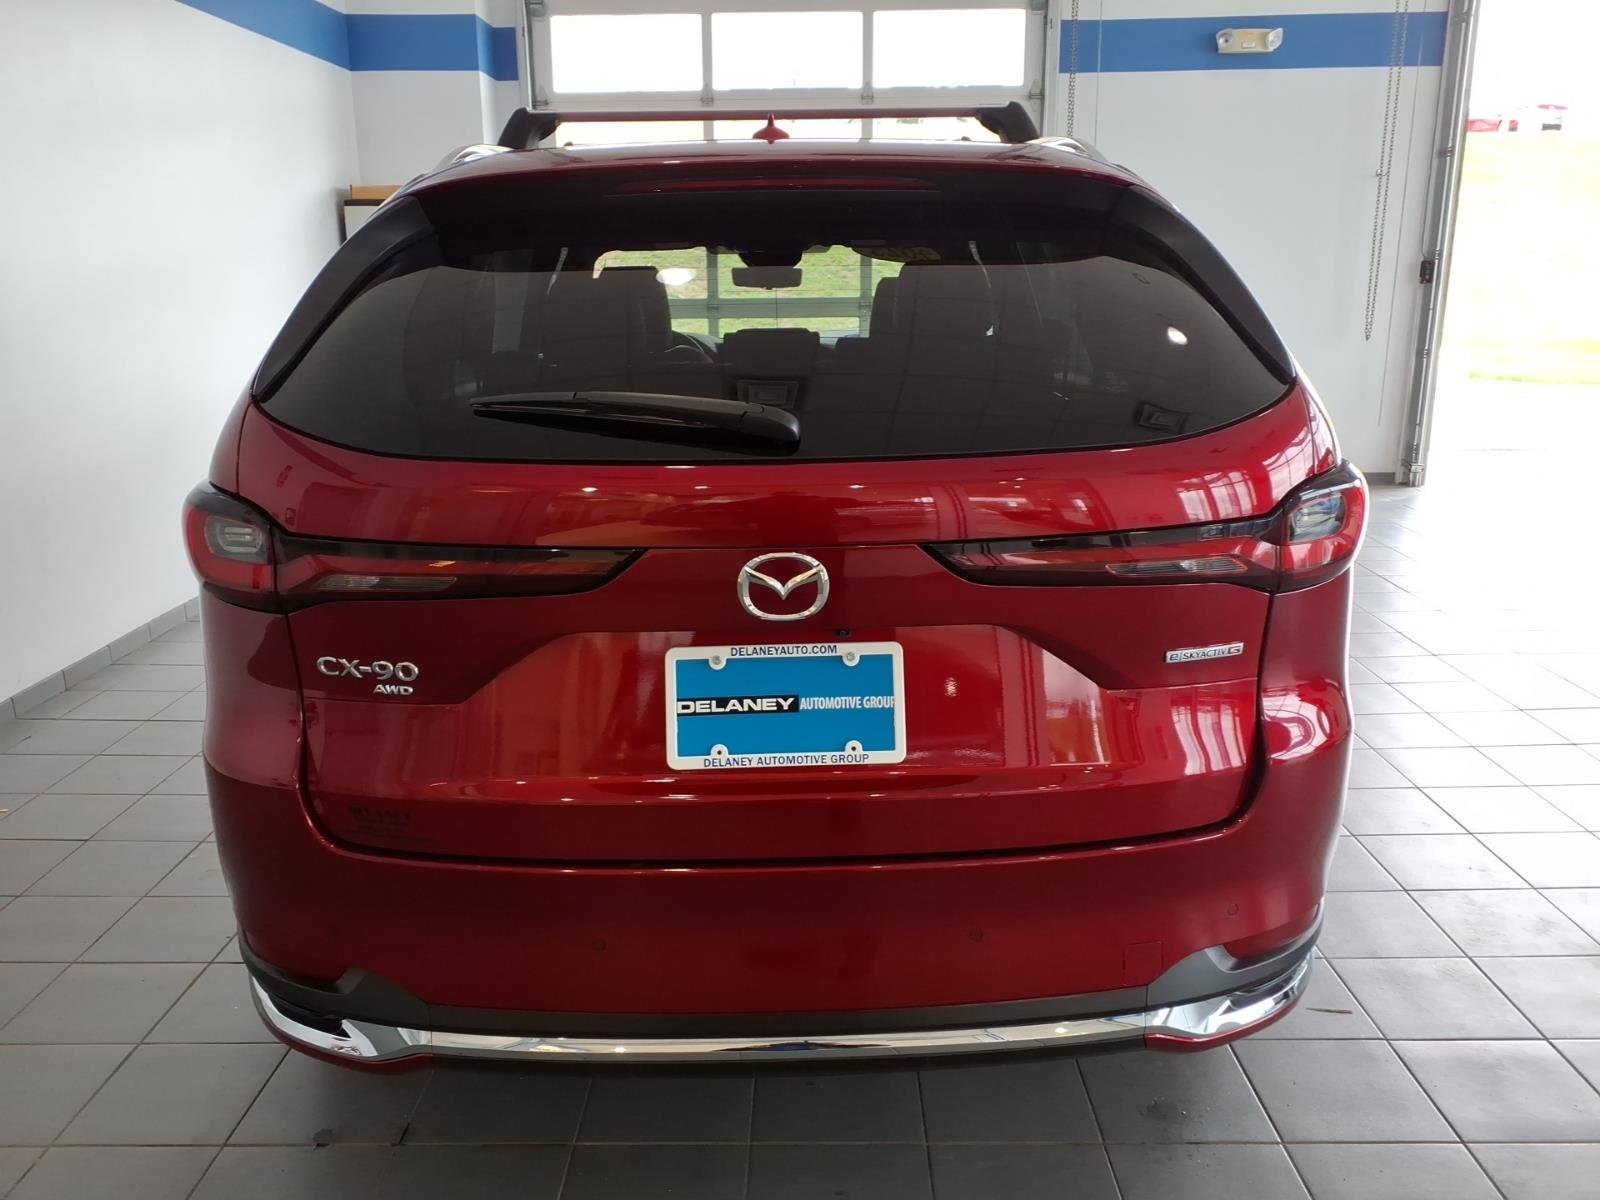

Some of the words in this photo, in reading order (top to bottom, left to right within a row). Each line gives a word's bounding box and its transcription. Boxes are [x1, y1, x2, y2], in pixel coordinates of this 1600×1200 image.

[730, 644, 838, 657] DELANEYAUTO.COM
[316, 656, 419, 682] CX-90
[373, 684, 414, 695] AWD
[677, 698, 794, 714] DELANEY
[799, 696, 862, 710] AUTOMOTIVE
[703, 756, 753, 768] DELANEY
[757, 755, 827, 765] AUTOMOTIVE
[830, 753, 869, 764] GROUP
